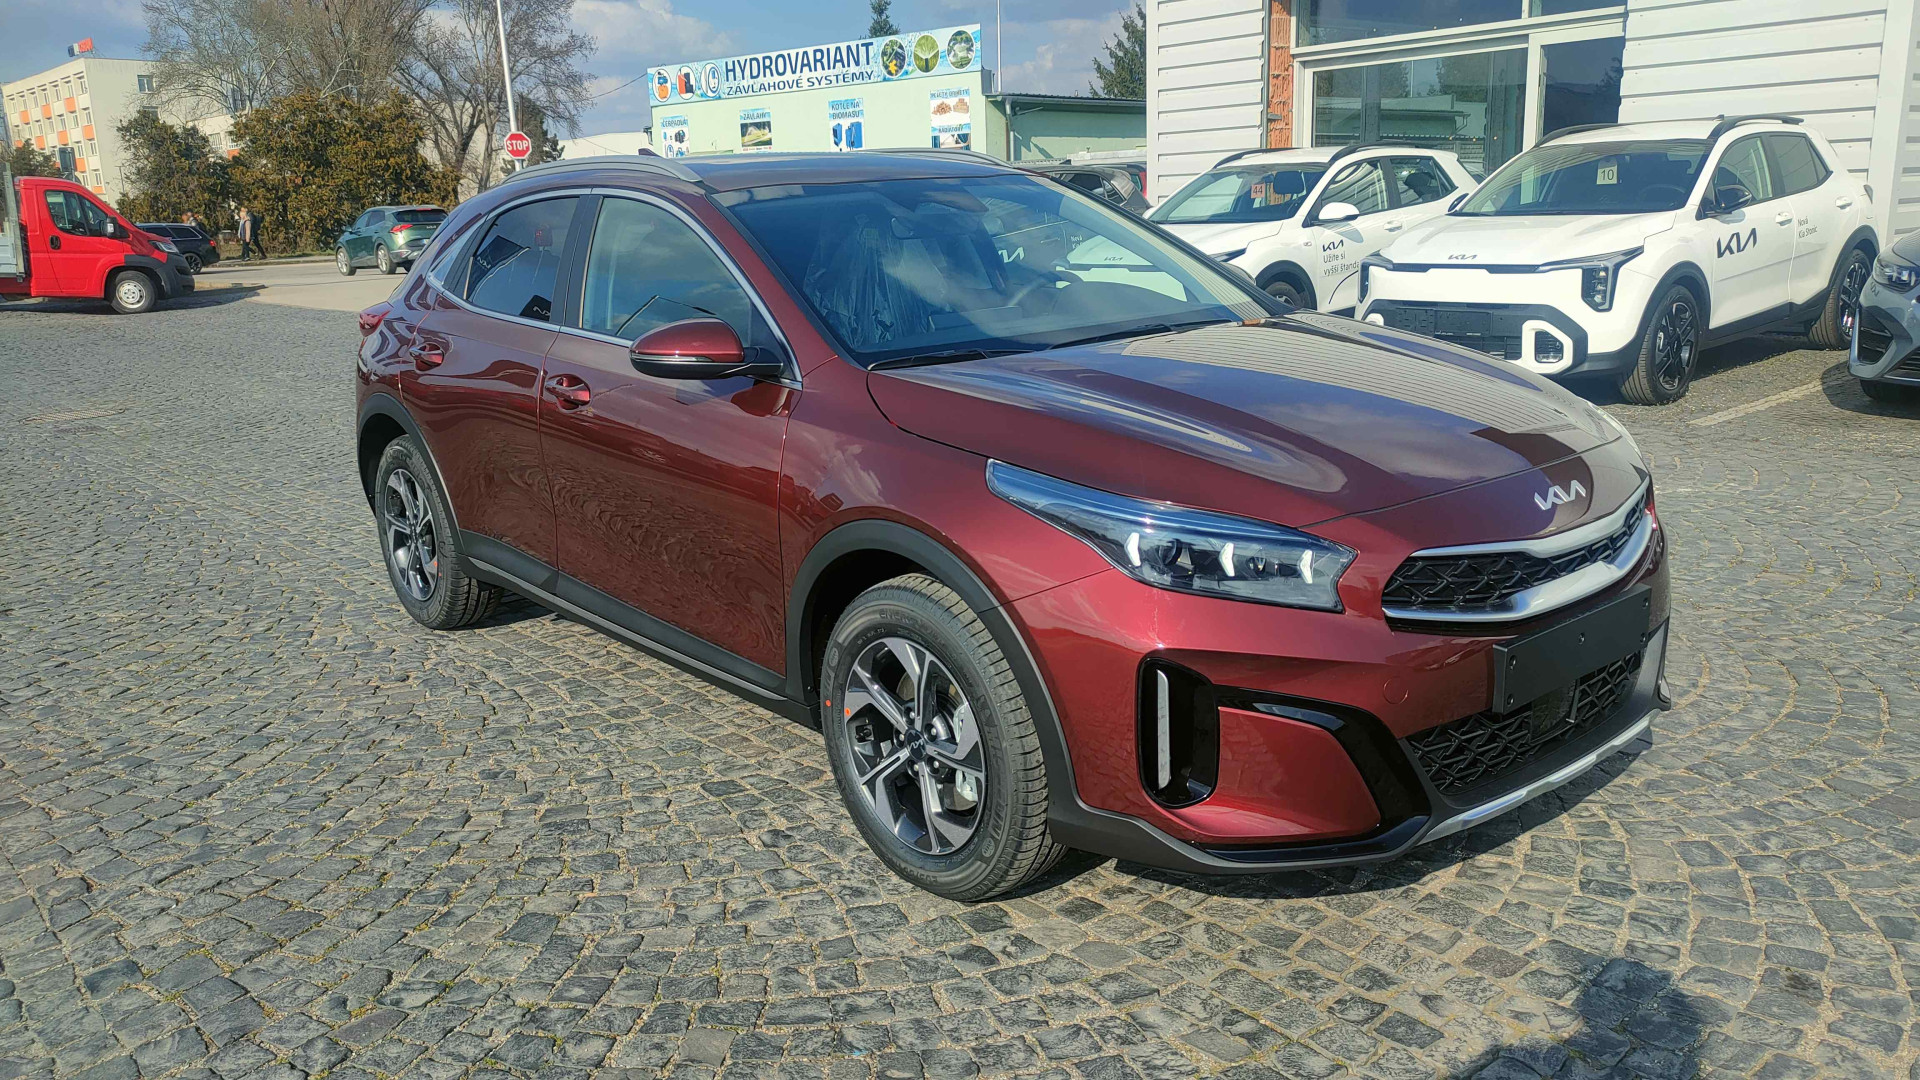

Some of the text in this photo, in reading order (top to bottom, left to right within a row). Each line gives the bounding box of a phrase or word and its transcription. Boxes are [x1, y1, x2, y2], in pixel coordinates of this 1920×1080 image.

[725, 41, 874, 83] HYDROVARIANT
[727, 70, 874, 96] ZÁVLAHOVÉ SYSTÉMY
[831, 100, 860, 111] KOTLE NA
[832, 110, 860, 119] BIOMASU
[506, 140, 528, 151] STOP
[1601, 169, 1614, 181] 10
[1252, 185, 1263, 195] 44
[1322, 239, 1344, 252] KIA
[1717, 227, 1757, 259] KIA
[998, 246, 1025, 263] IA
[1323, 250, 1346, 264] Užite si
[1534, 479, 1587, 511] KIA
